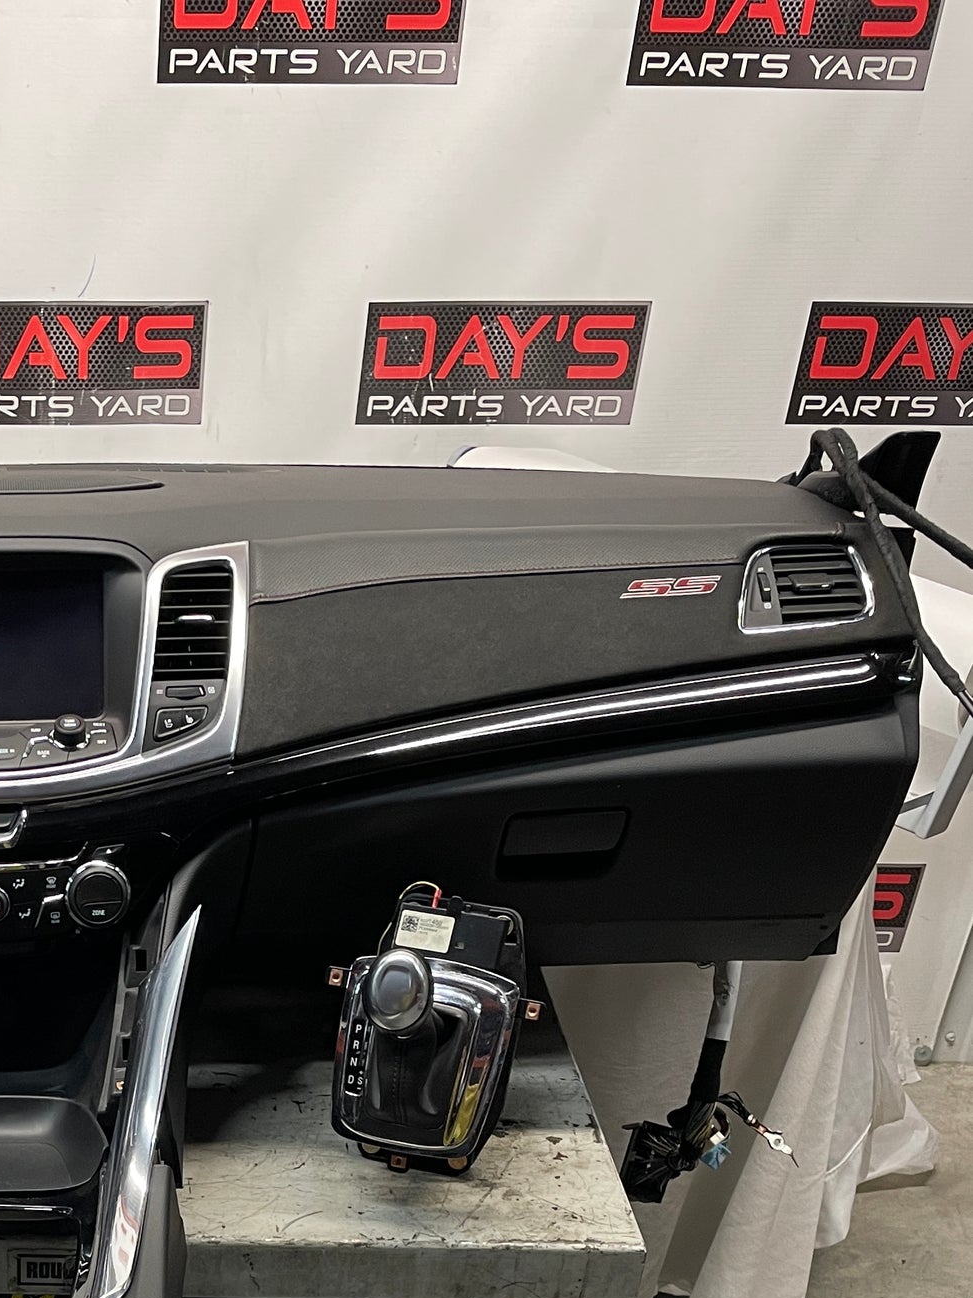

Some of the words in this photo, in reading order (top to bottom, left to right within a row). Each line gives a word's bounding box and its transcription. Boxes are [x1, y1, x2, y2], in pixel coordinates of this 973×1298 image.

[169, 48, 319, 76] PARTS
[338, 48, 447, 76] YARD
[639, 51, 791, 79] PARTS
[809, 54, 918, 81] YARD
[372, 314, 636, 381] DAY'S
[90, 394, 191, 417] YARD
[366, 394, 505, 418] PARTS
[520, 395, 623, 418] YARD
[797, 395, 939, 417] PARTS
[619, 575, 723, 600] SS
[355, 1024, 363, 1034] P
[352, 1040, 360, 1050] R
[349, 1057, 358, 1067] N
[347, 1074, 355, 1085] D
[357, 1076, 364, 1086] S
